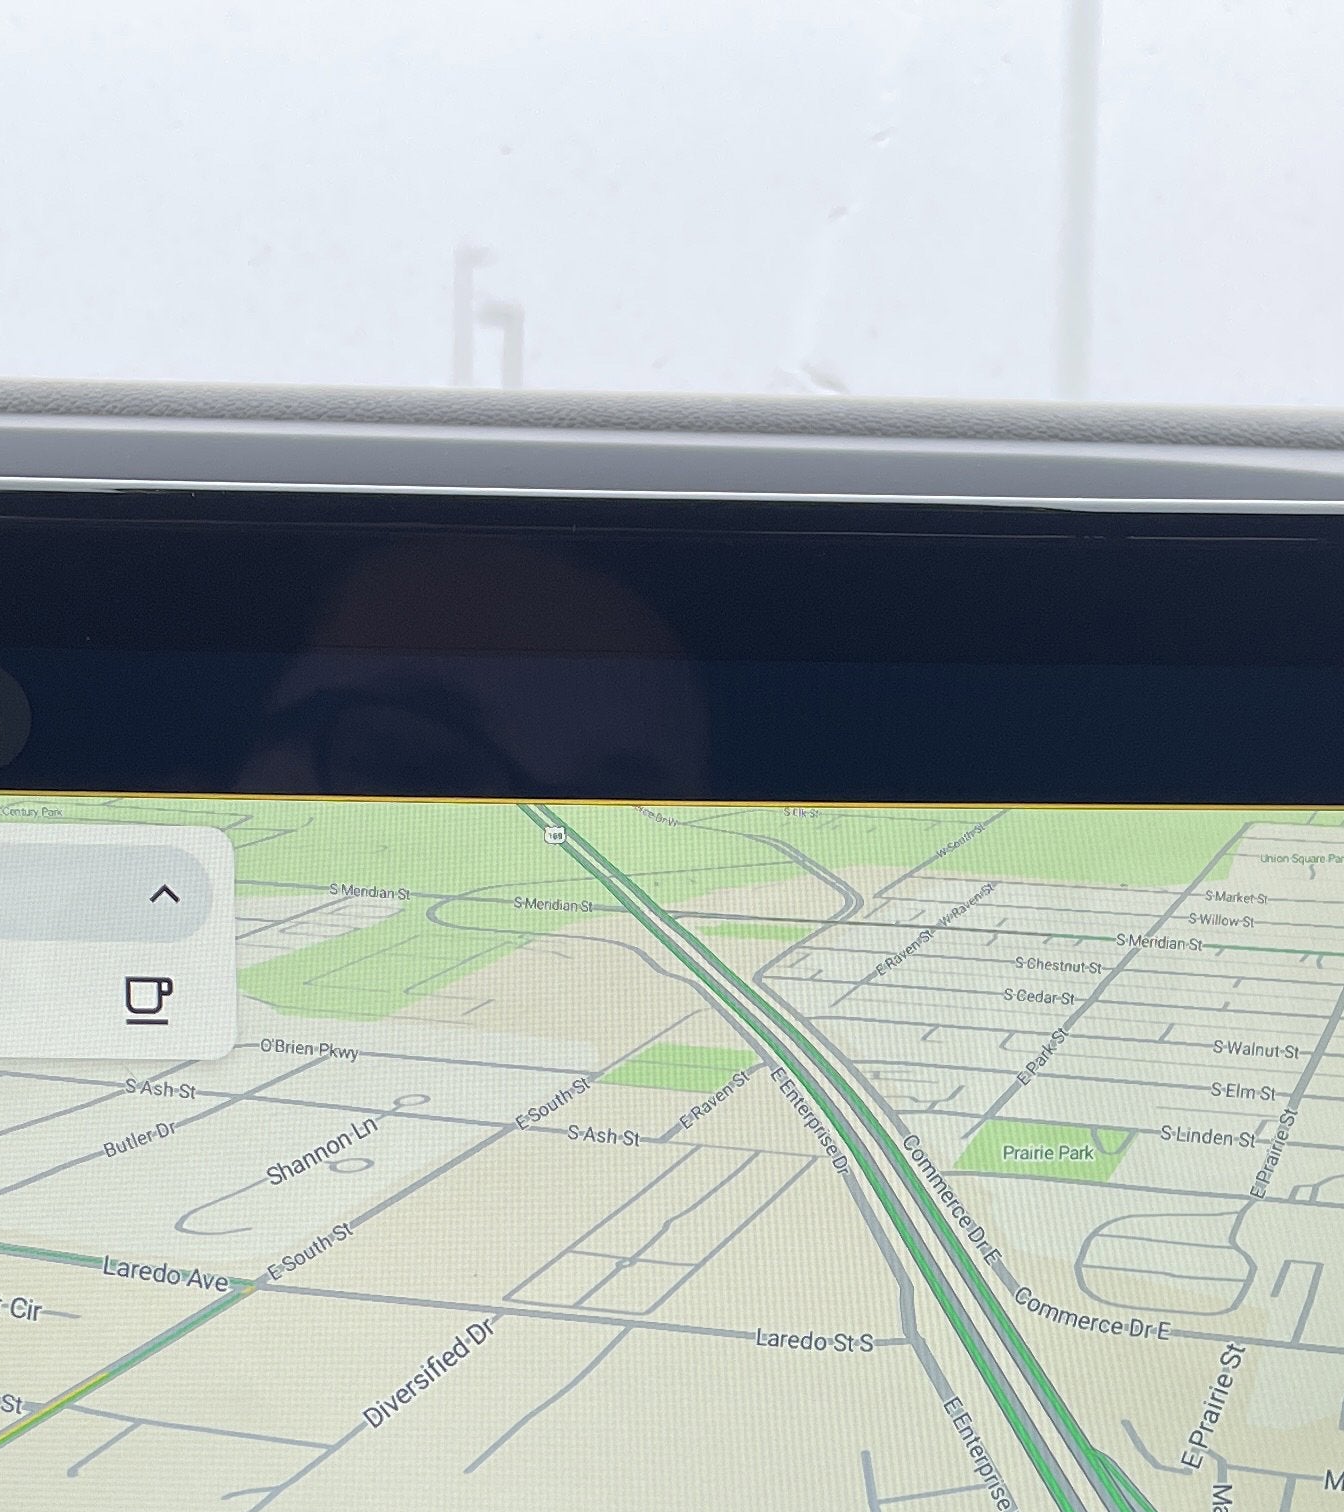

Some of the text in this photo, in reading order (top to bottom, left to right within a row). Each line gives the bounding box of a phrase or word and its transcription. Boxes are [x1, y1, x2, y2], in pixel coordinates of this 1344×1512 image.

[1260, 854, 1289, 863] Union
[1292, 854, 1325, 865] Square
[1116, 935, 1203, 950] S Meridian St
[1015, 957, 1102, 974] S Chestnut St
[1004, 989, 1075, 1005] S Cedar St
[260, 1038, 359, 1063] O'Brien Pkwy
[1017, 1027, 1069, 1086] E Park St
[1213, 1041, 1299, 1059] S Walnut St
[125, 1078, 197, 1099] S Ash St
[680, 1069, 751, 1130] E Raven St
[1211, 1082, 1276, 1101] S Elm St
[516, 1076, 592, 1131] E South St
[770, 1067, 850, 1176] E Enterprise Dr
[103, 1120, 177, 1158] Butler Dr
[568, 1124, 641, 1147] S Ash St
[266, 1117, 379, 1187] Shannon Ln
[1003, 1145, 1093, 1161] Prairie Park
[1250, 1108, 1299, 1199] E Prairie St
[903, 1134, 1003, 1266] Commerce Dr E
[268, 1221, 354, 1281] E South St
[103, 1255, 229, 1293] Laredo Ave
[10, 1297, 44, 1323] Cir
[1015, 1287, 1172, 1341] Commerce Dr E
[755, 1327, 875, 1353] Laredo St S
[362, 1317, 496, 1430] Diversified Dr
[0, 1394, 24, 1415] St
[944, 1395, 962, 1416] E
[1180, 1341, 1246, 1471] E Prairie St
